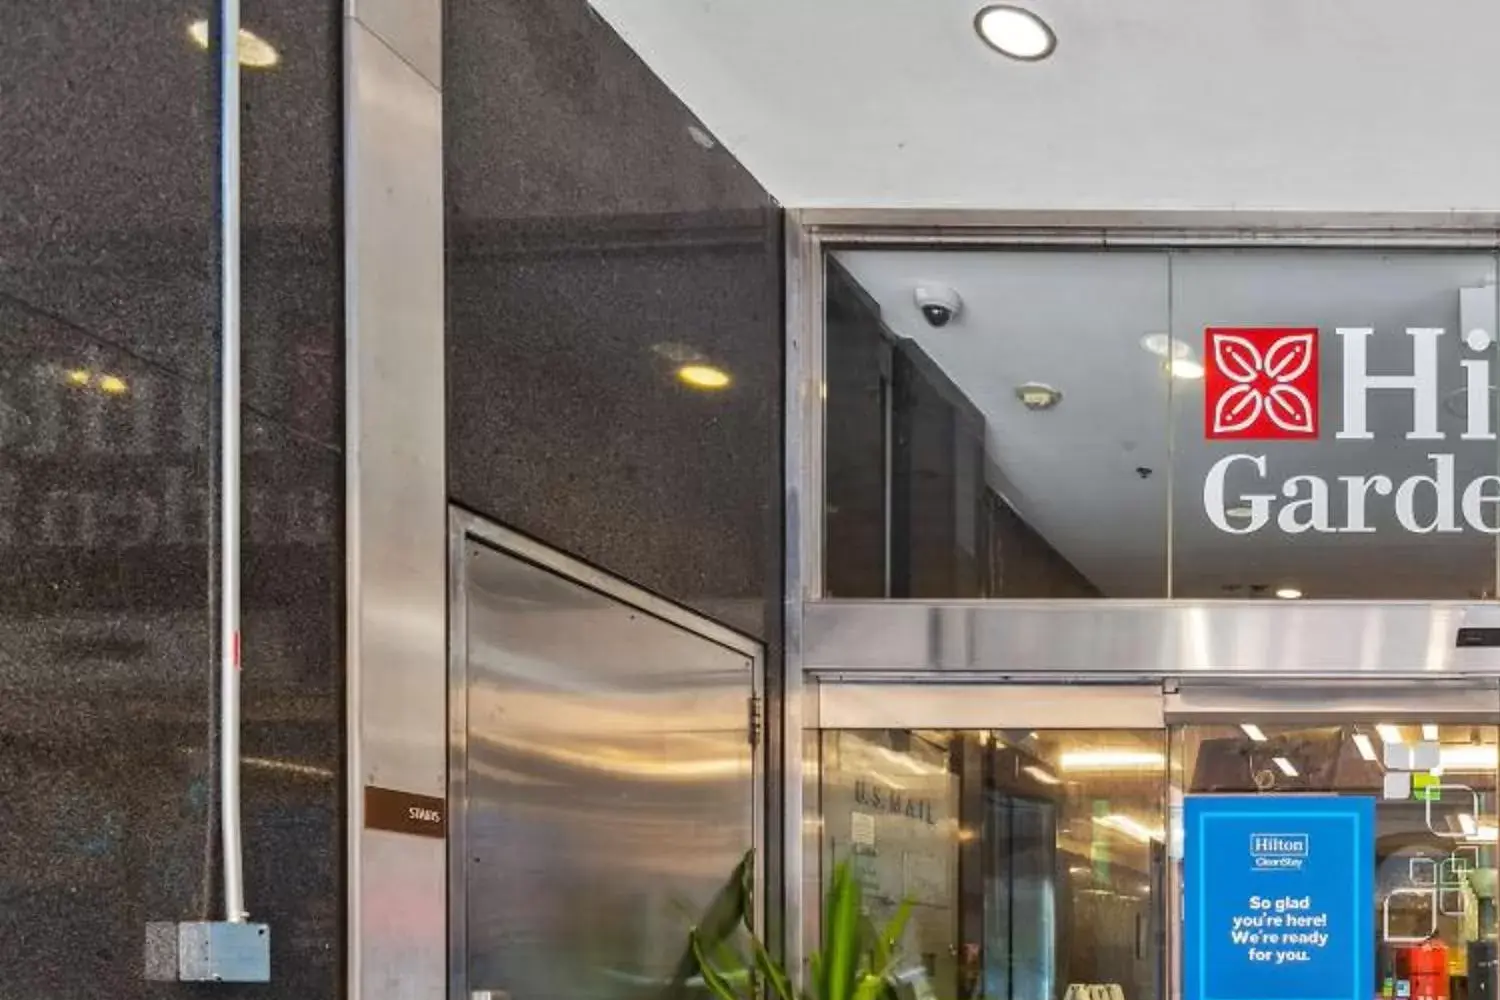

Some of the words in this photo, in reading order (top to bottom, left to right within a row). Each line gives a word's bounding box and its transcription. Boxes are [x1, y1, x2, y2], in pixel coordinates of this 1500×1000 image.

[889, 789, 934, 825] MAIL
[1255, 838, 1303, 852] Hilton
[1249, 896, 1271, 910] So
[1276, 896, 1310, 912] glad
[1233, 913, 1282, 929] you're
[1286, 913, 1327, 927] here!
[1231, 931, 1278, 944] We're
[1282, 931, 1328, 947] ready
[1248, 948, 1273, 961] for
[1276, 950, 1310, 964] you.
